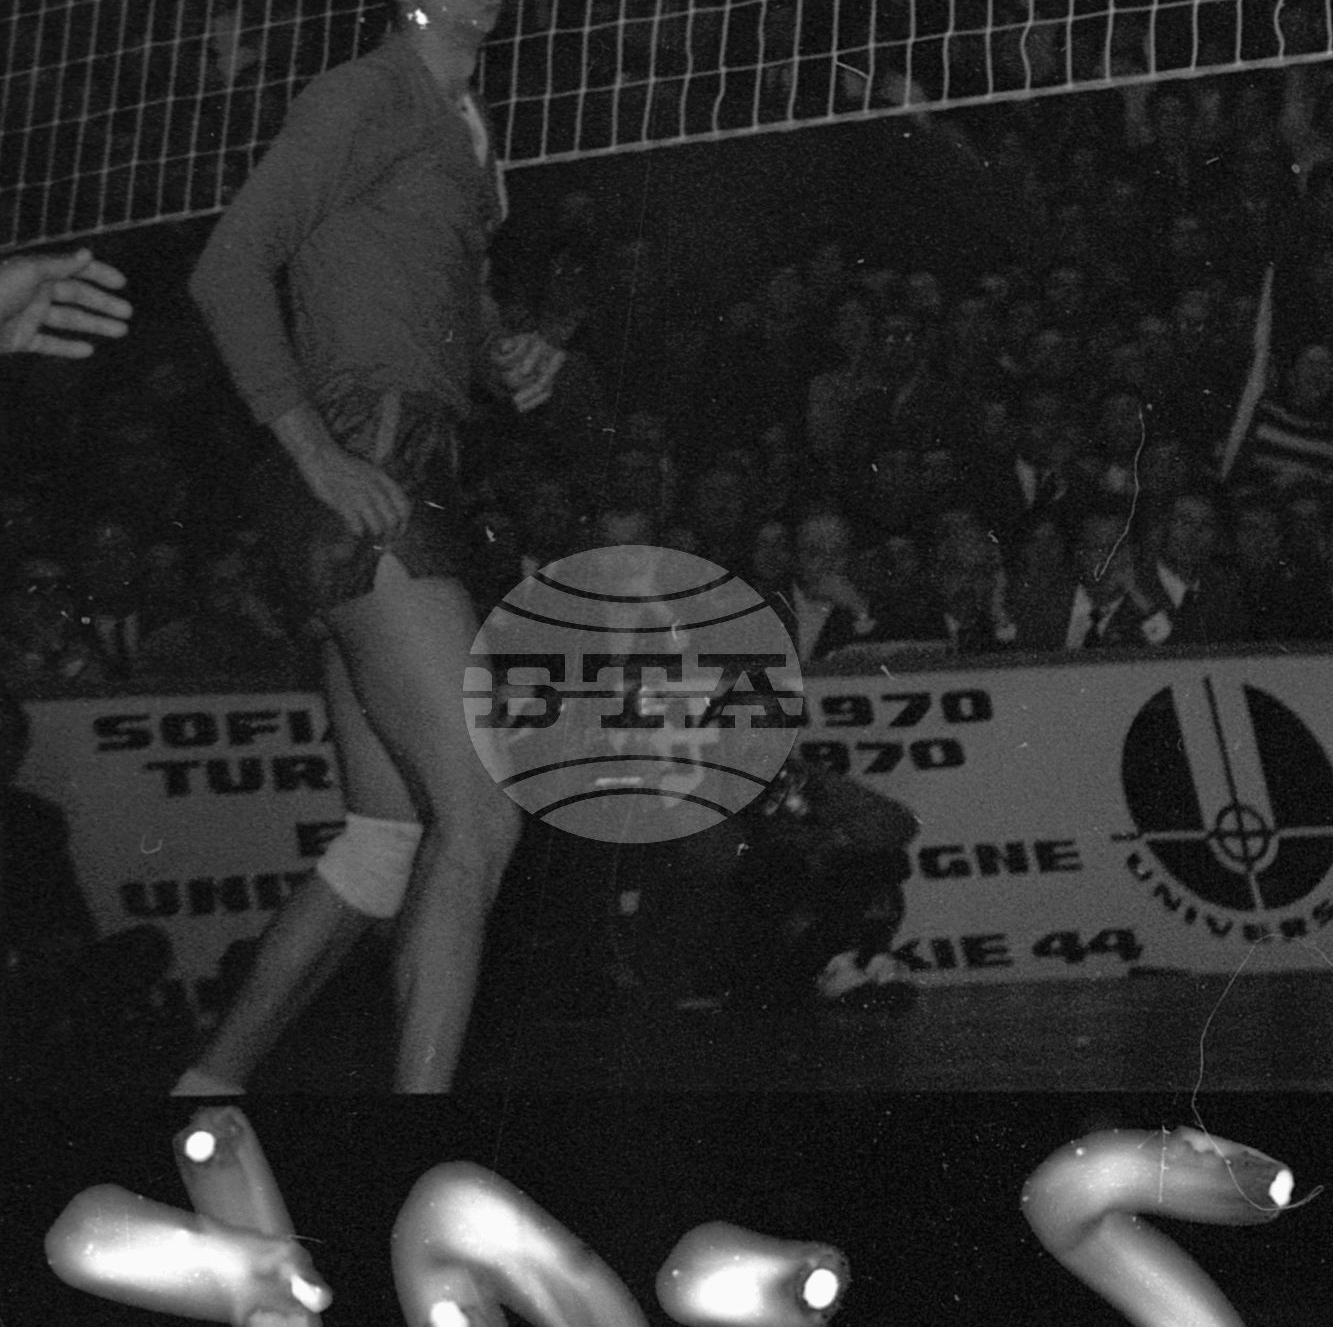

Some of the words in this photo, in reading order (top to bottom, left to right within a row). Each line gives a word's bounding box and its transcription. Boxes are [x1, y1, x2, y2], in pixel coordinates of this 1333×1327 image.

[93, 708, 333, 752] SOFI
[145, 755, 334, 797] TUR
[800, 739, 965, 775] 970
[904, 837, 1083, 879] GNE
[894, 935, 1012, 971] KIE
[1034, 928, 1143, 963] 44
